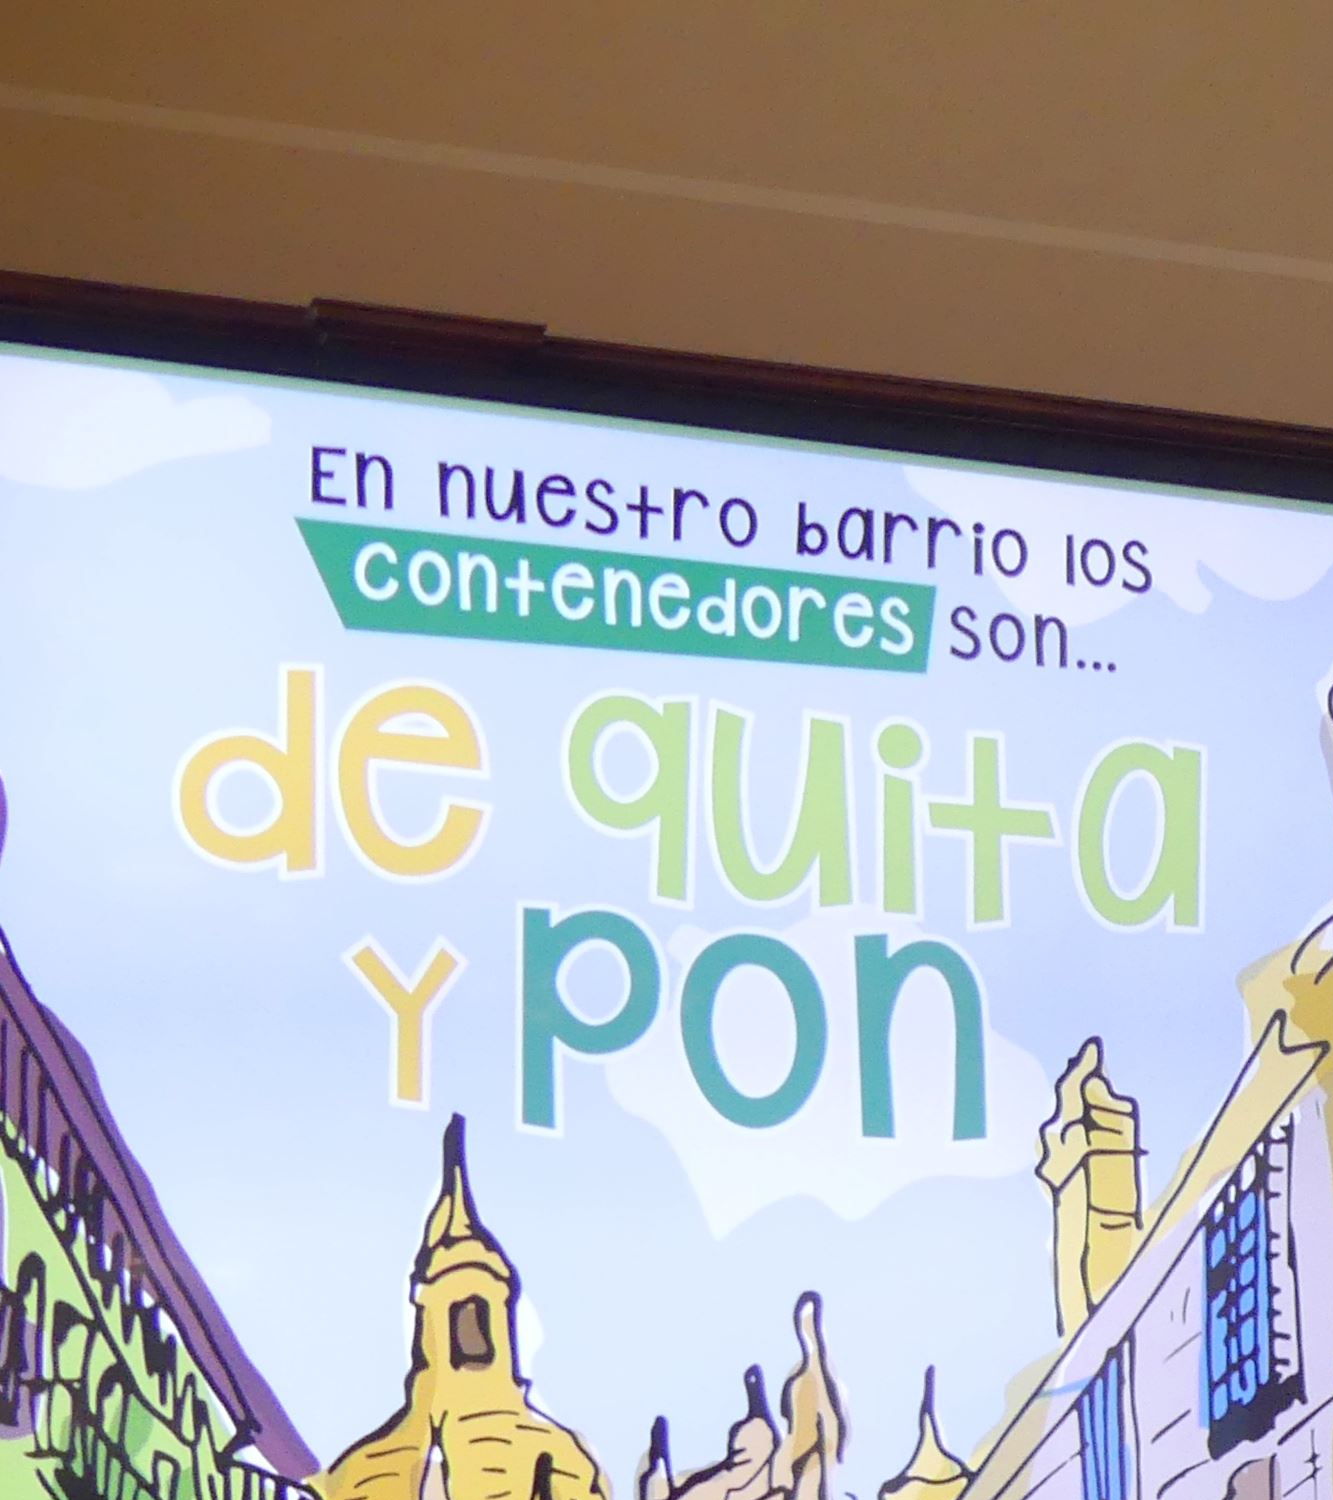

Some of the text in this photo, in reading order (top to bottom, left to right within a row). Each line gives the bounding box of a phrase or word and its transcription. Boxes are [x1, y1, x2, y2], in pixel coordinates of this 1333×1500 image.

[312, 446, 1152, 594] En nuestro barrio los
[353, 540, 915, 654] contenedores
[174, 665, 1207, 929] de quita
[518, 905, 990, 1142] pon
